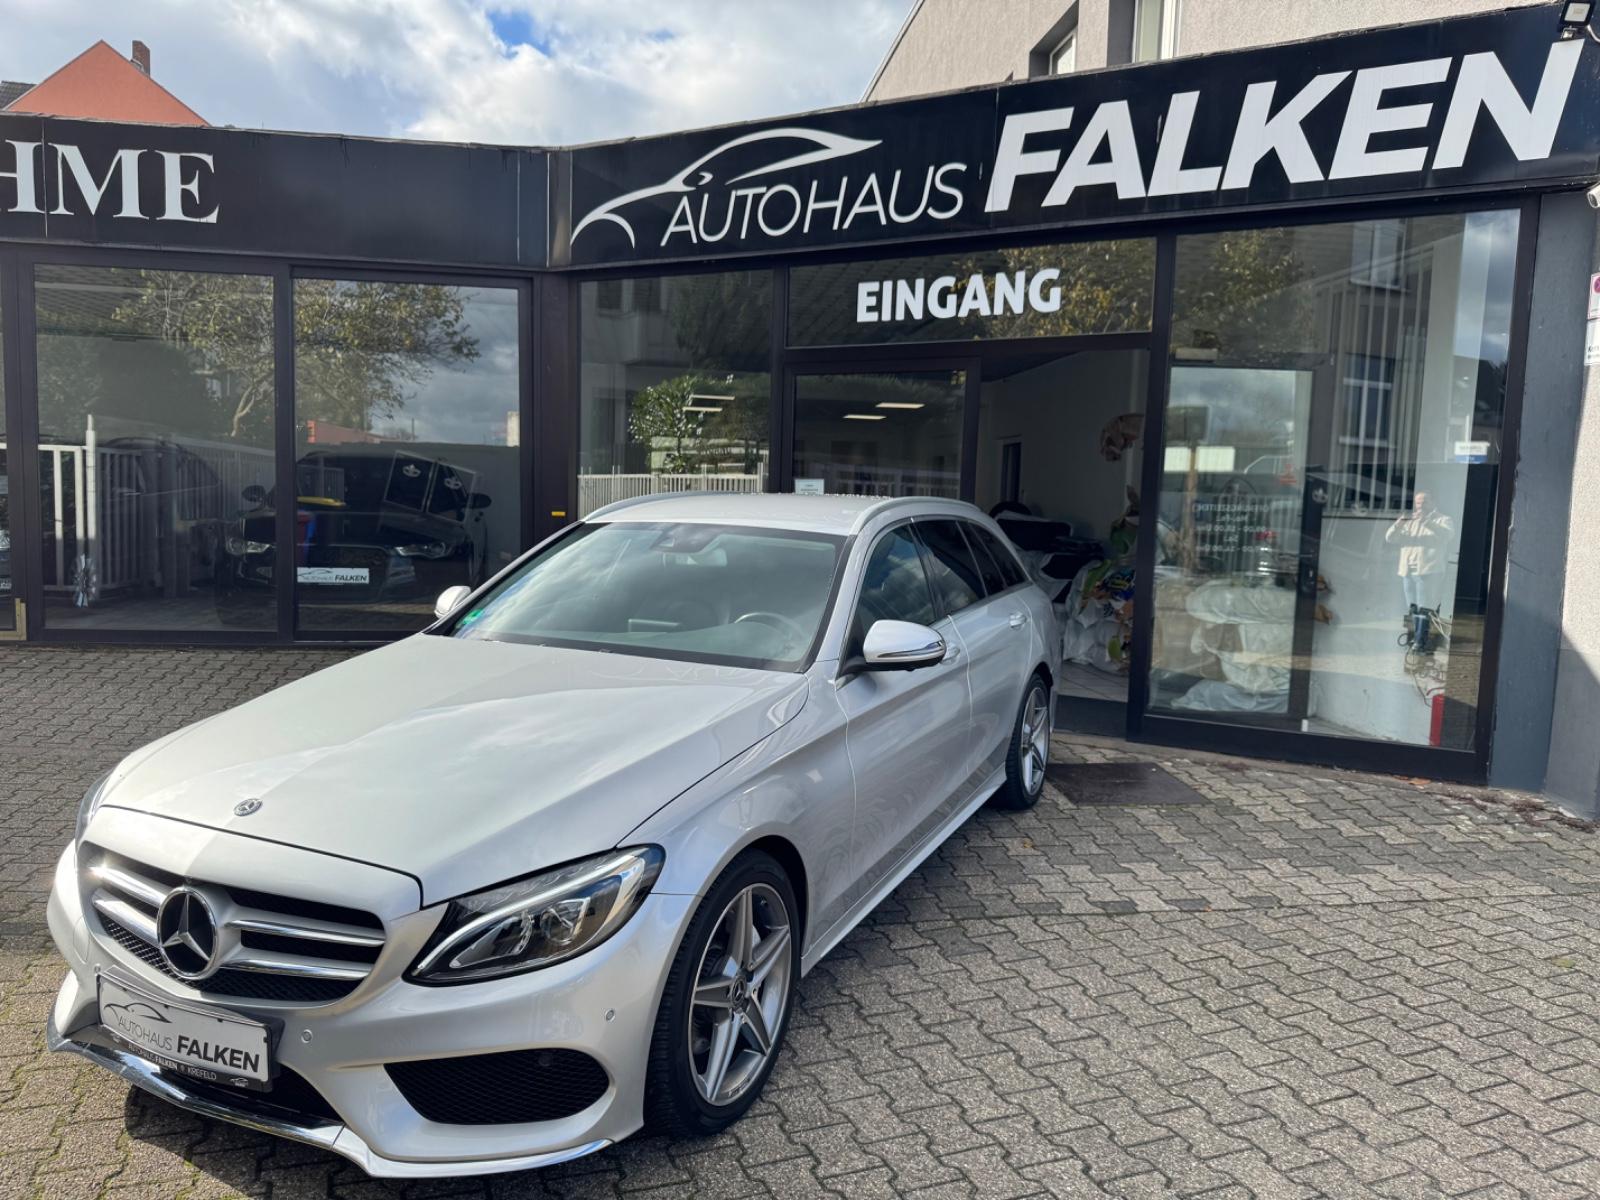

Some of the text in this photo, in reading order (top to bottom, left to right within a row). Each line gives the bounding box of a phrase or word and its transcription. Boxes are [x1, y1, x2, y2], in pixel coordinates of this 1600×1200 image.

[660, 38, 1585, 246] AUTOHAUS FALKEN
[856, 268, 1062, 322] EINGANG
[118, 1015, 260, 1073] AUTOHAUS FALKEN
[187, 1066, 217, 1081] KREFELD
